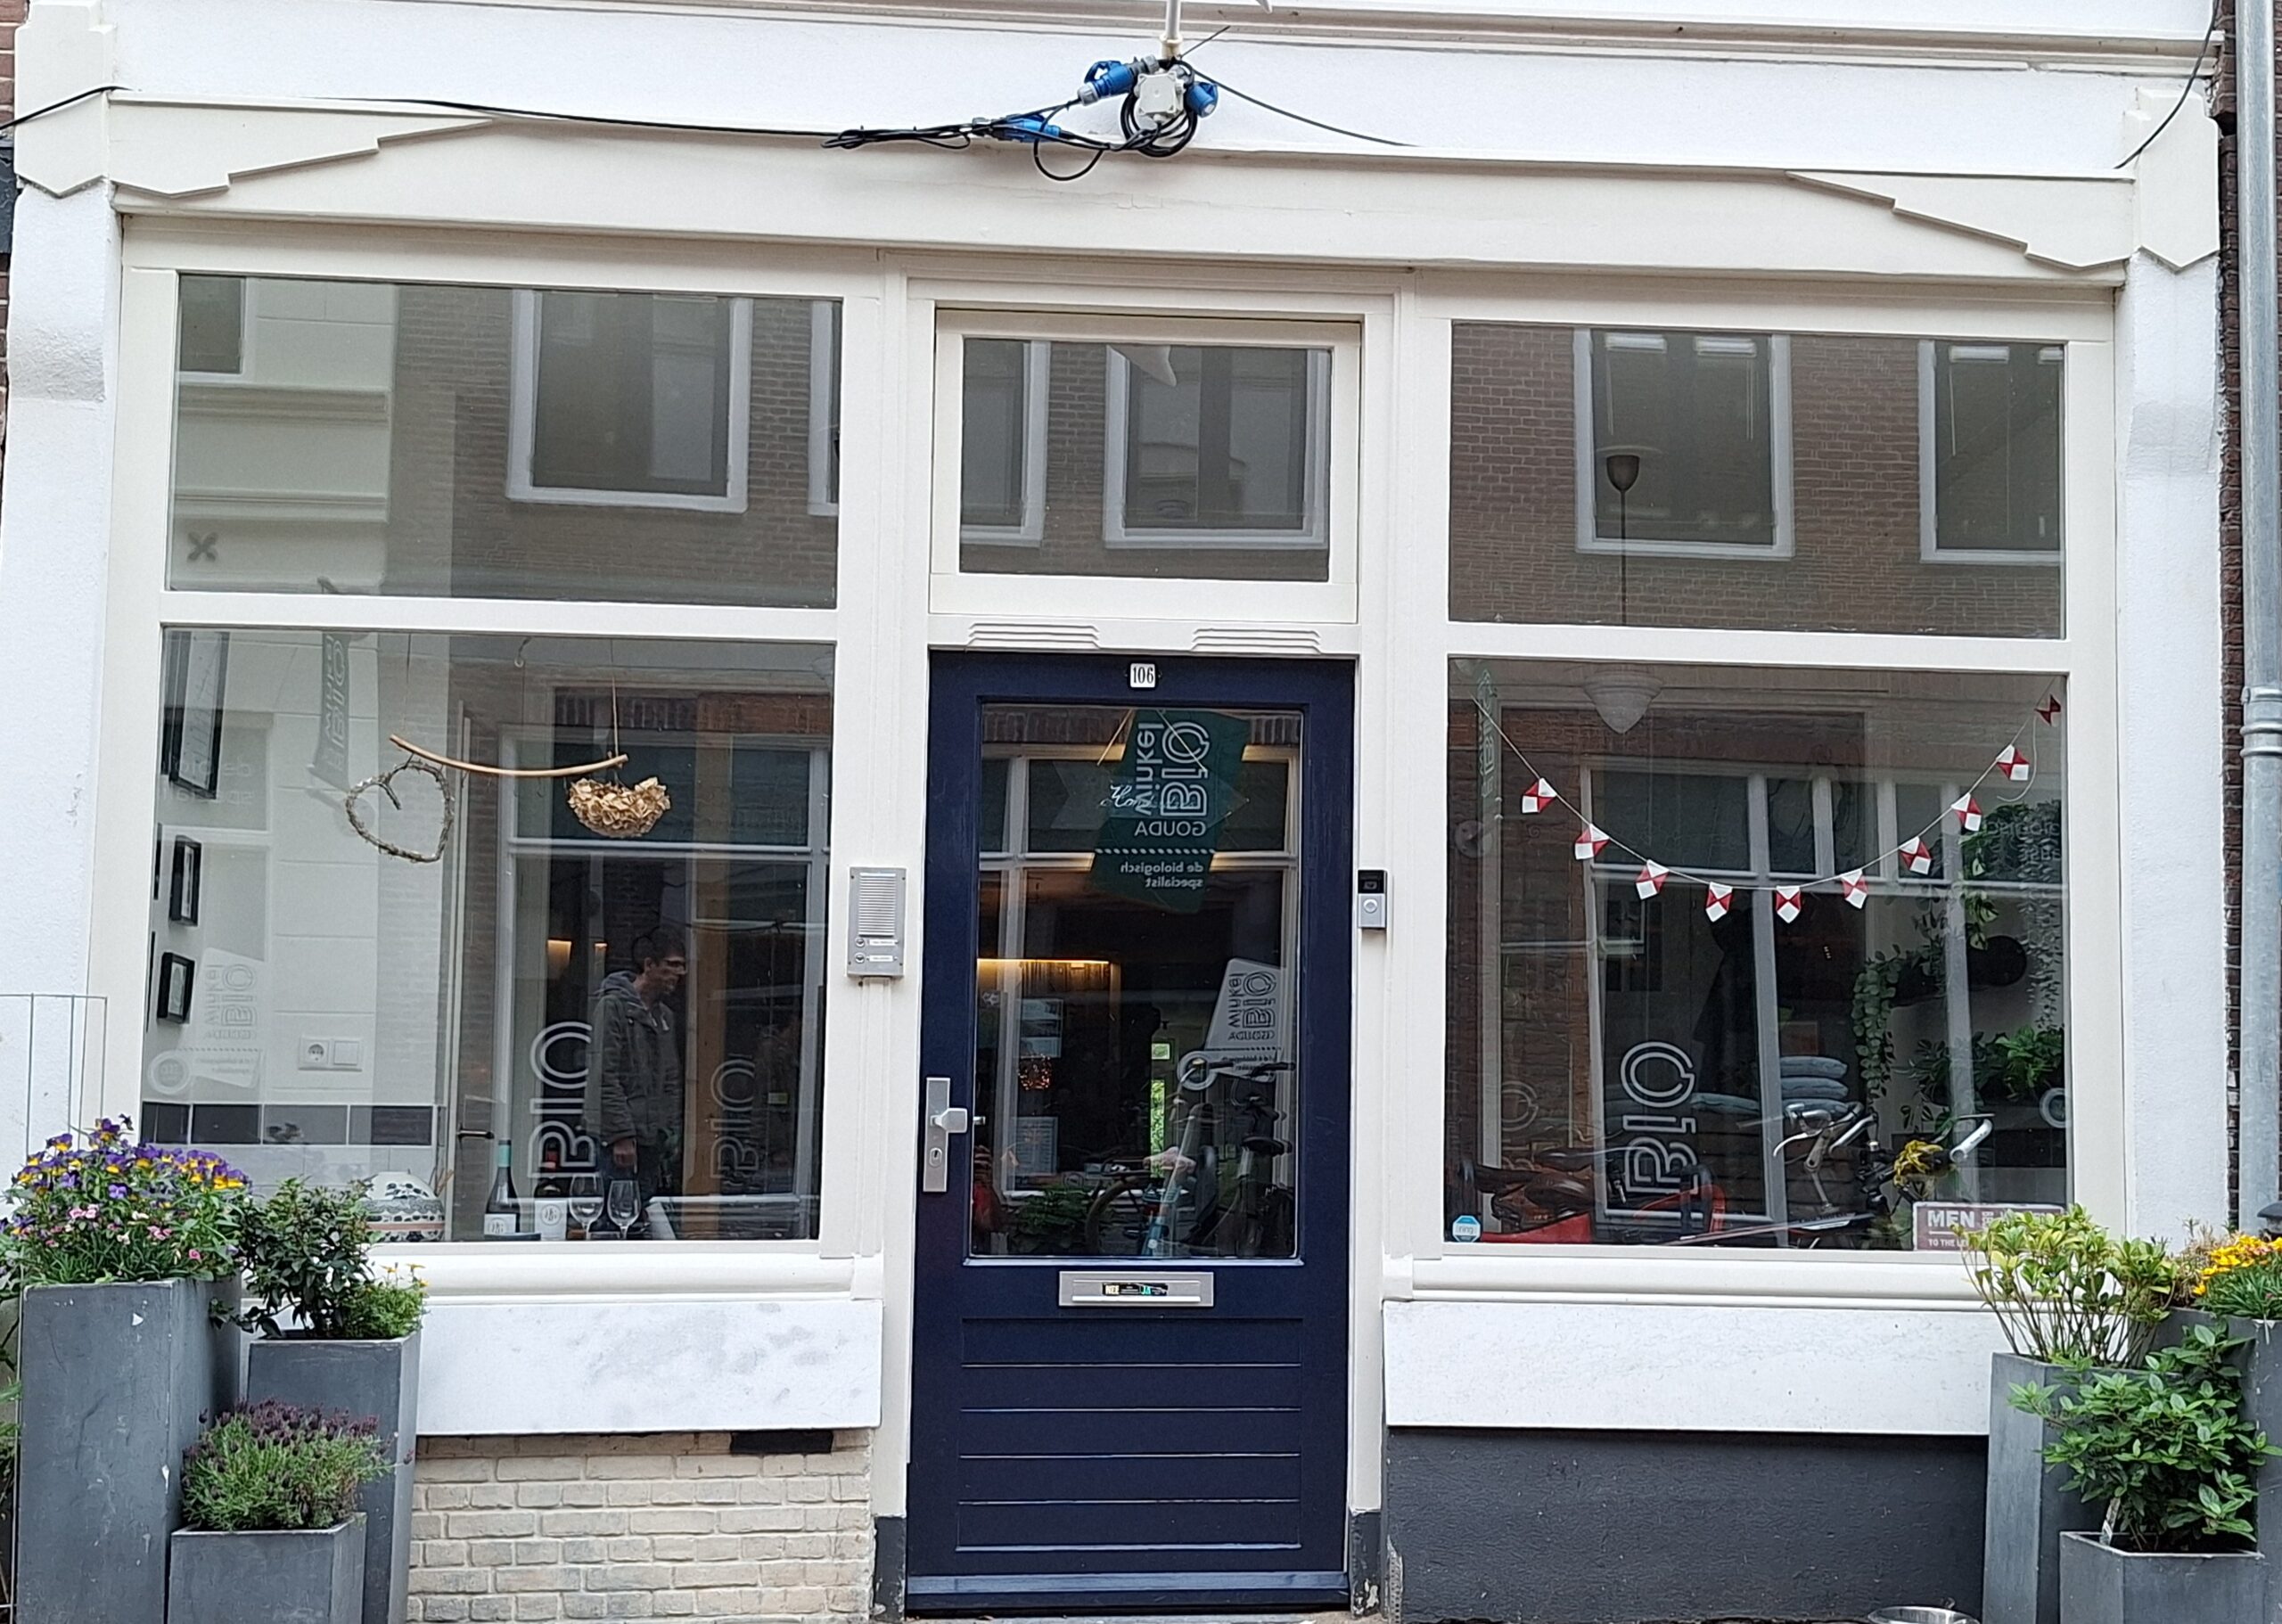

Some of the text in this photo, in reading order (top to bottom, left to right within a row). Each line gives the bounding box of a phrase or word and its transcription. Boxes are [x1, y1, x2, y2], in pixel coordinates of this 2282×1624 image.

[1132, 666, 1155, 685] 106
[1927, 1209, 1975, 1228] MEN
[1457, 1225, 1474, 1235] ring
[1928, 1238, 1939, 1247] TO
[1940, 1238, 1955, 1247] THE
